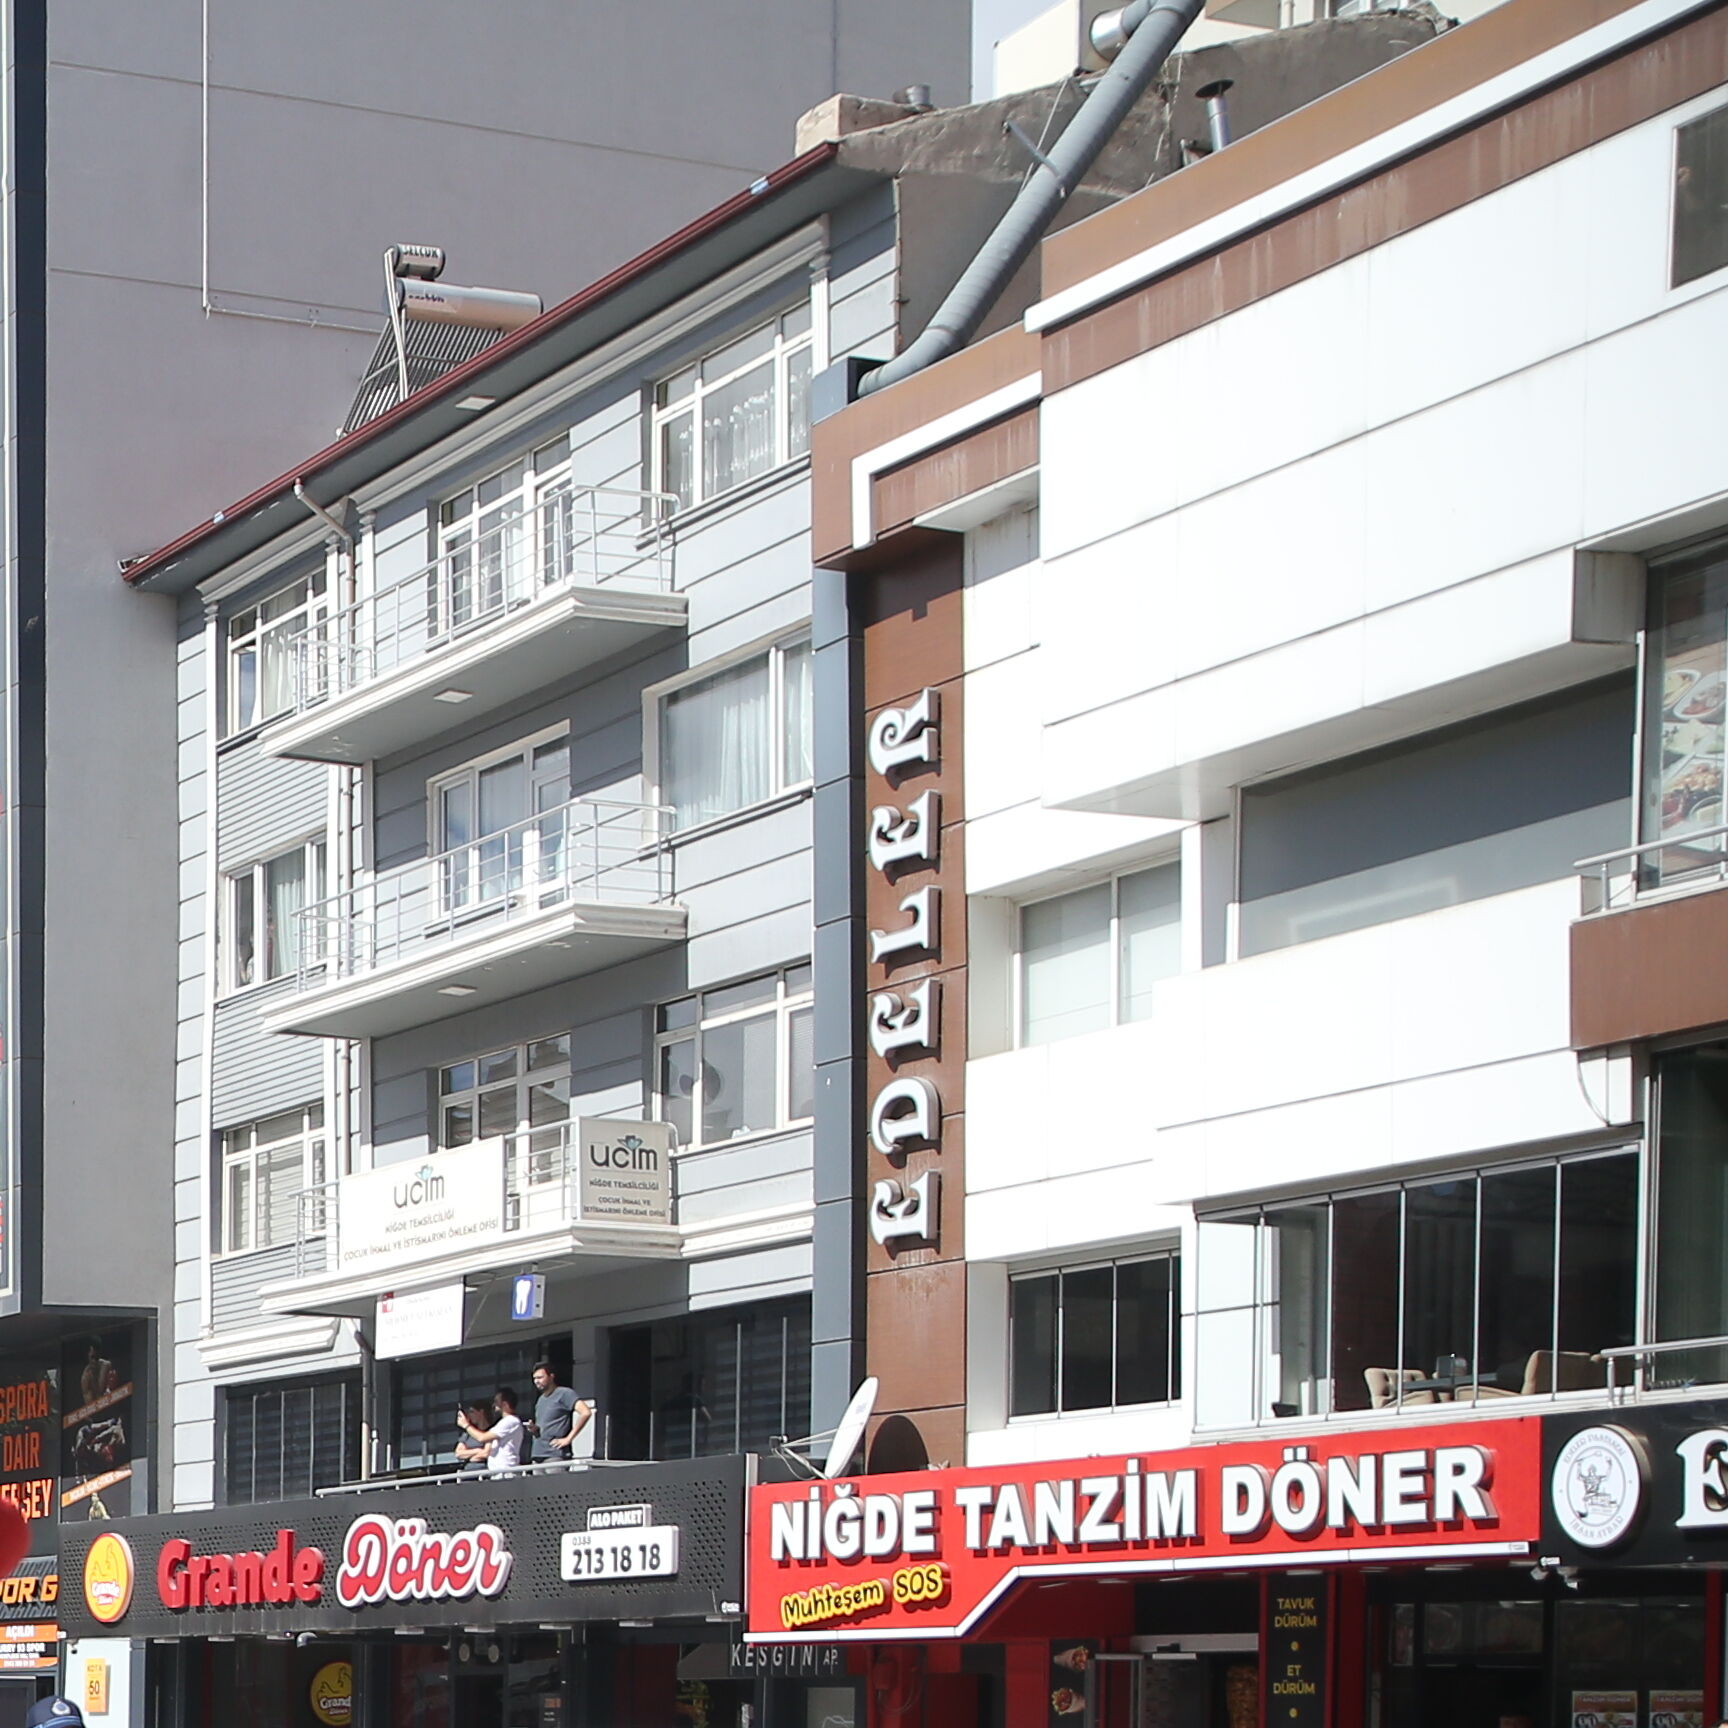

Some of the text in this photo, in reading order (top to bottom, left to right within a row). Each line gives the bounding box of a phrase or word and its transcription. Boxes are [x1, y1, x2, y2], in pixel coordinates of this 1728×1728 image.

[867, 686, 942, 1255] EDELER
[2, 1426, 40, 1472] DAİR
[590, 1510, 643, 1528] ALO PAKET
[771, 1444, 1498, 1562] NİĞDE TANZİM DÖNER
[157, 1515, 508, 1608] Grande Döner
[572, 1543, 661, 1575] 213 18 18
[783, 1567, 940, 1623] Muhteşem SOS
[1277, 1598, 1315, 1610] TAVUK
[1274, 1614, 1317, 1628] DÜRÜM
[1287, 1664, 1302, 1676] ET
[1273, 1681, 1316, 1695] DÜRÜM
